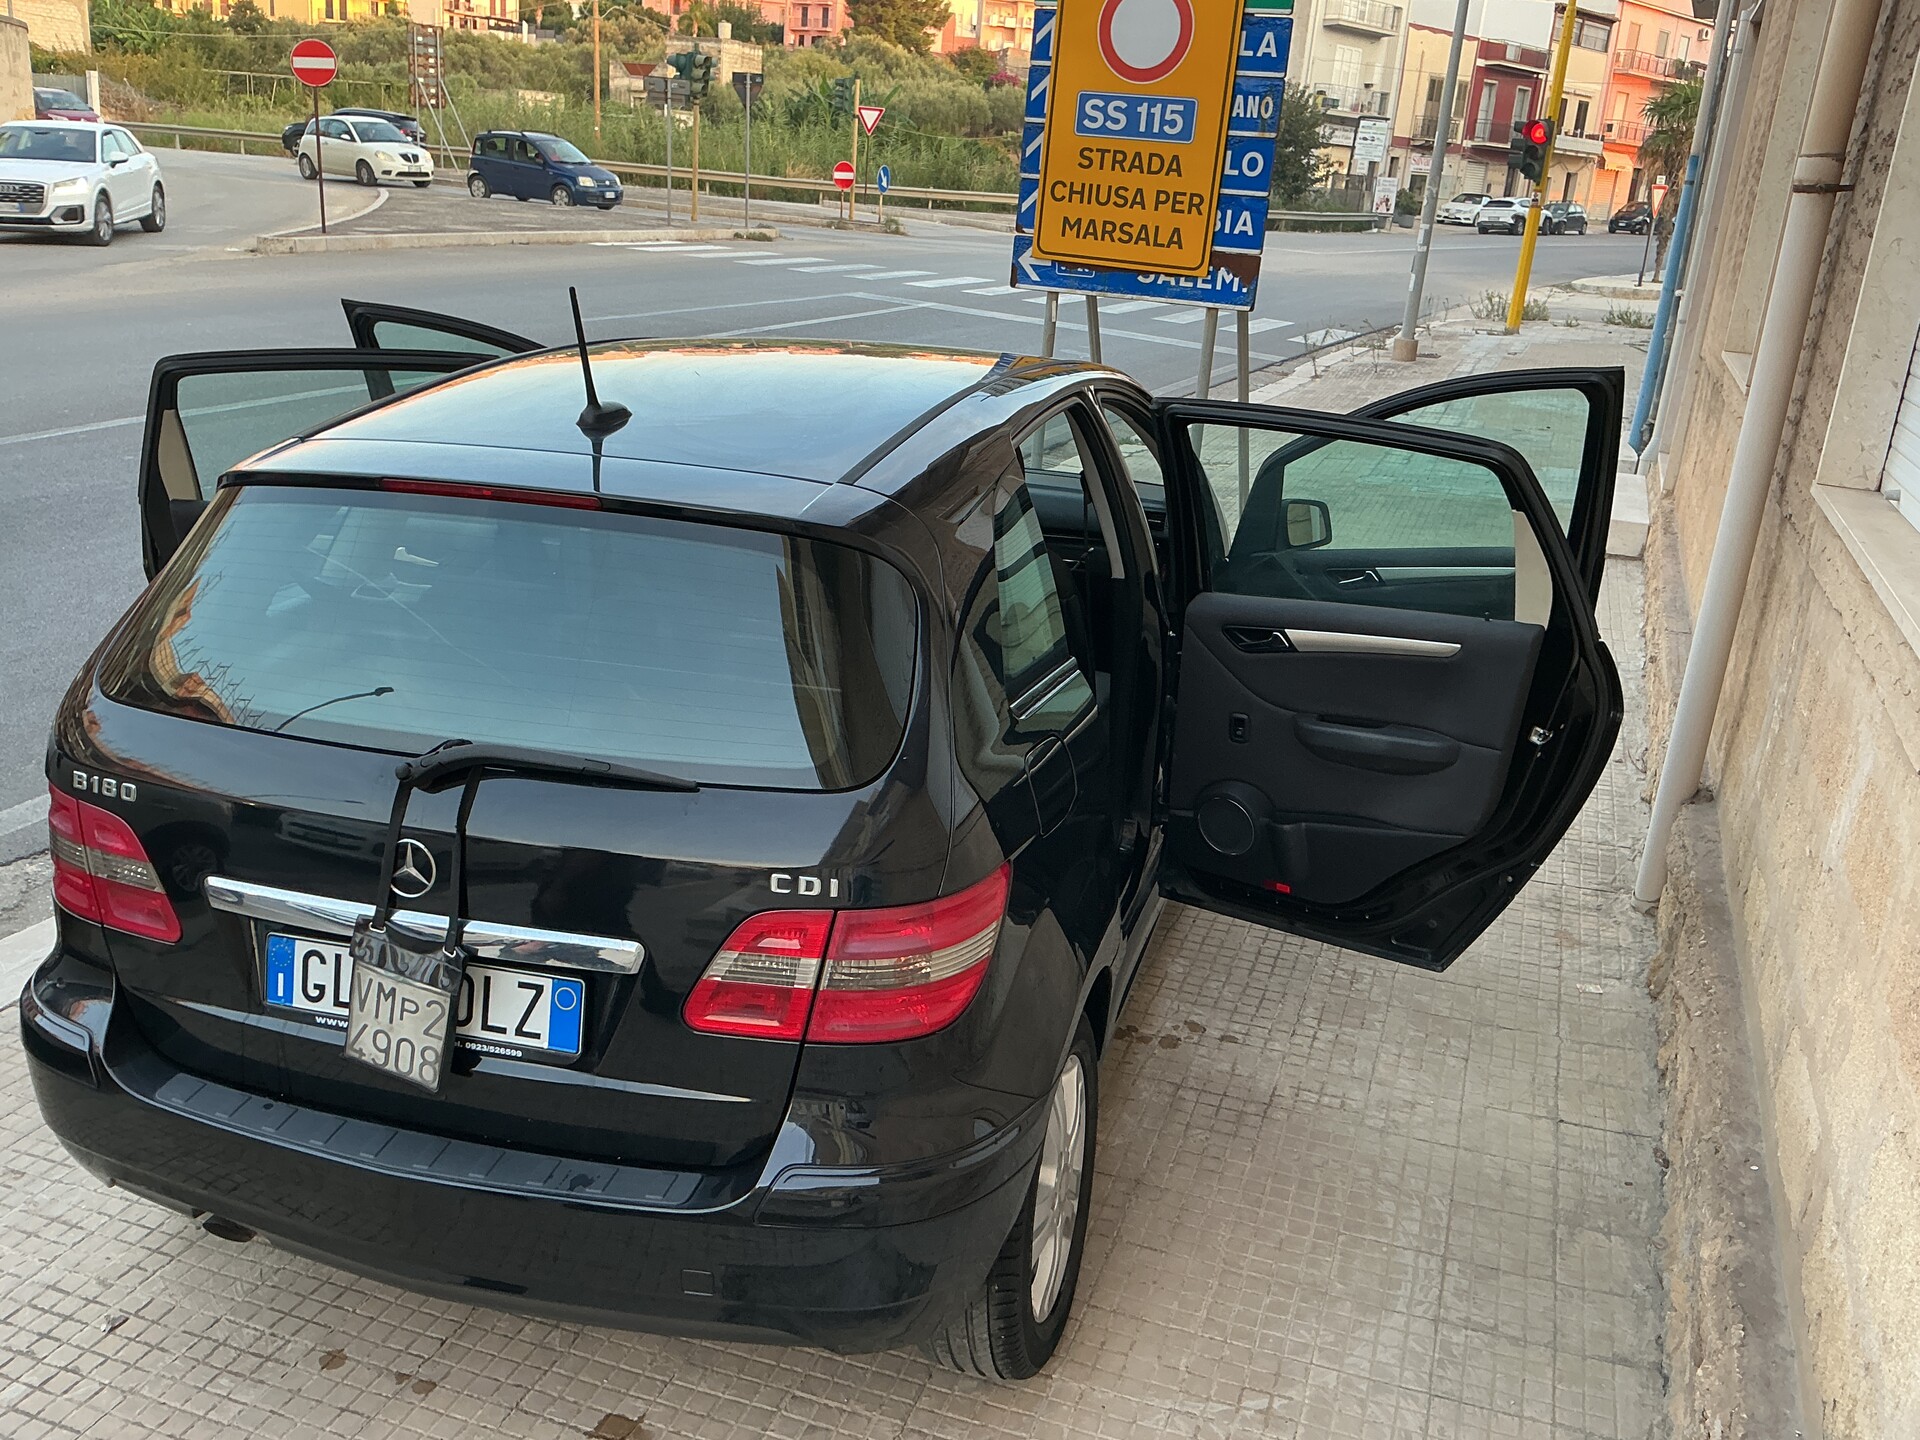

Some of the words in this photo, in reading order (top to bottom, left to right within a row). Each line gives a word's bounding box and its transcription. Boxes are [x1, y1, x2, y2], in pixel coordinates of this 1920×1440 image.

[1082, 98, 1128, 131] SS
[1136, 102, 1185, 135] 115
[1077, 146, 1183, 178] STRADA
[1049, 179, 1147, 211] CHIUSA
[1153, 189, 1205, 216] PER
[1061, 215, 1184, 250] MARSALA
[72, 770, 137, 803] B180
[769, 873, 839, 898] CDI
[350, 1023, 441, 1085] 4908
[465, 1042, 523, 1058] 0923/526599
